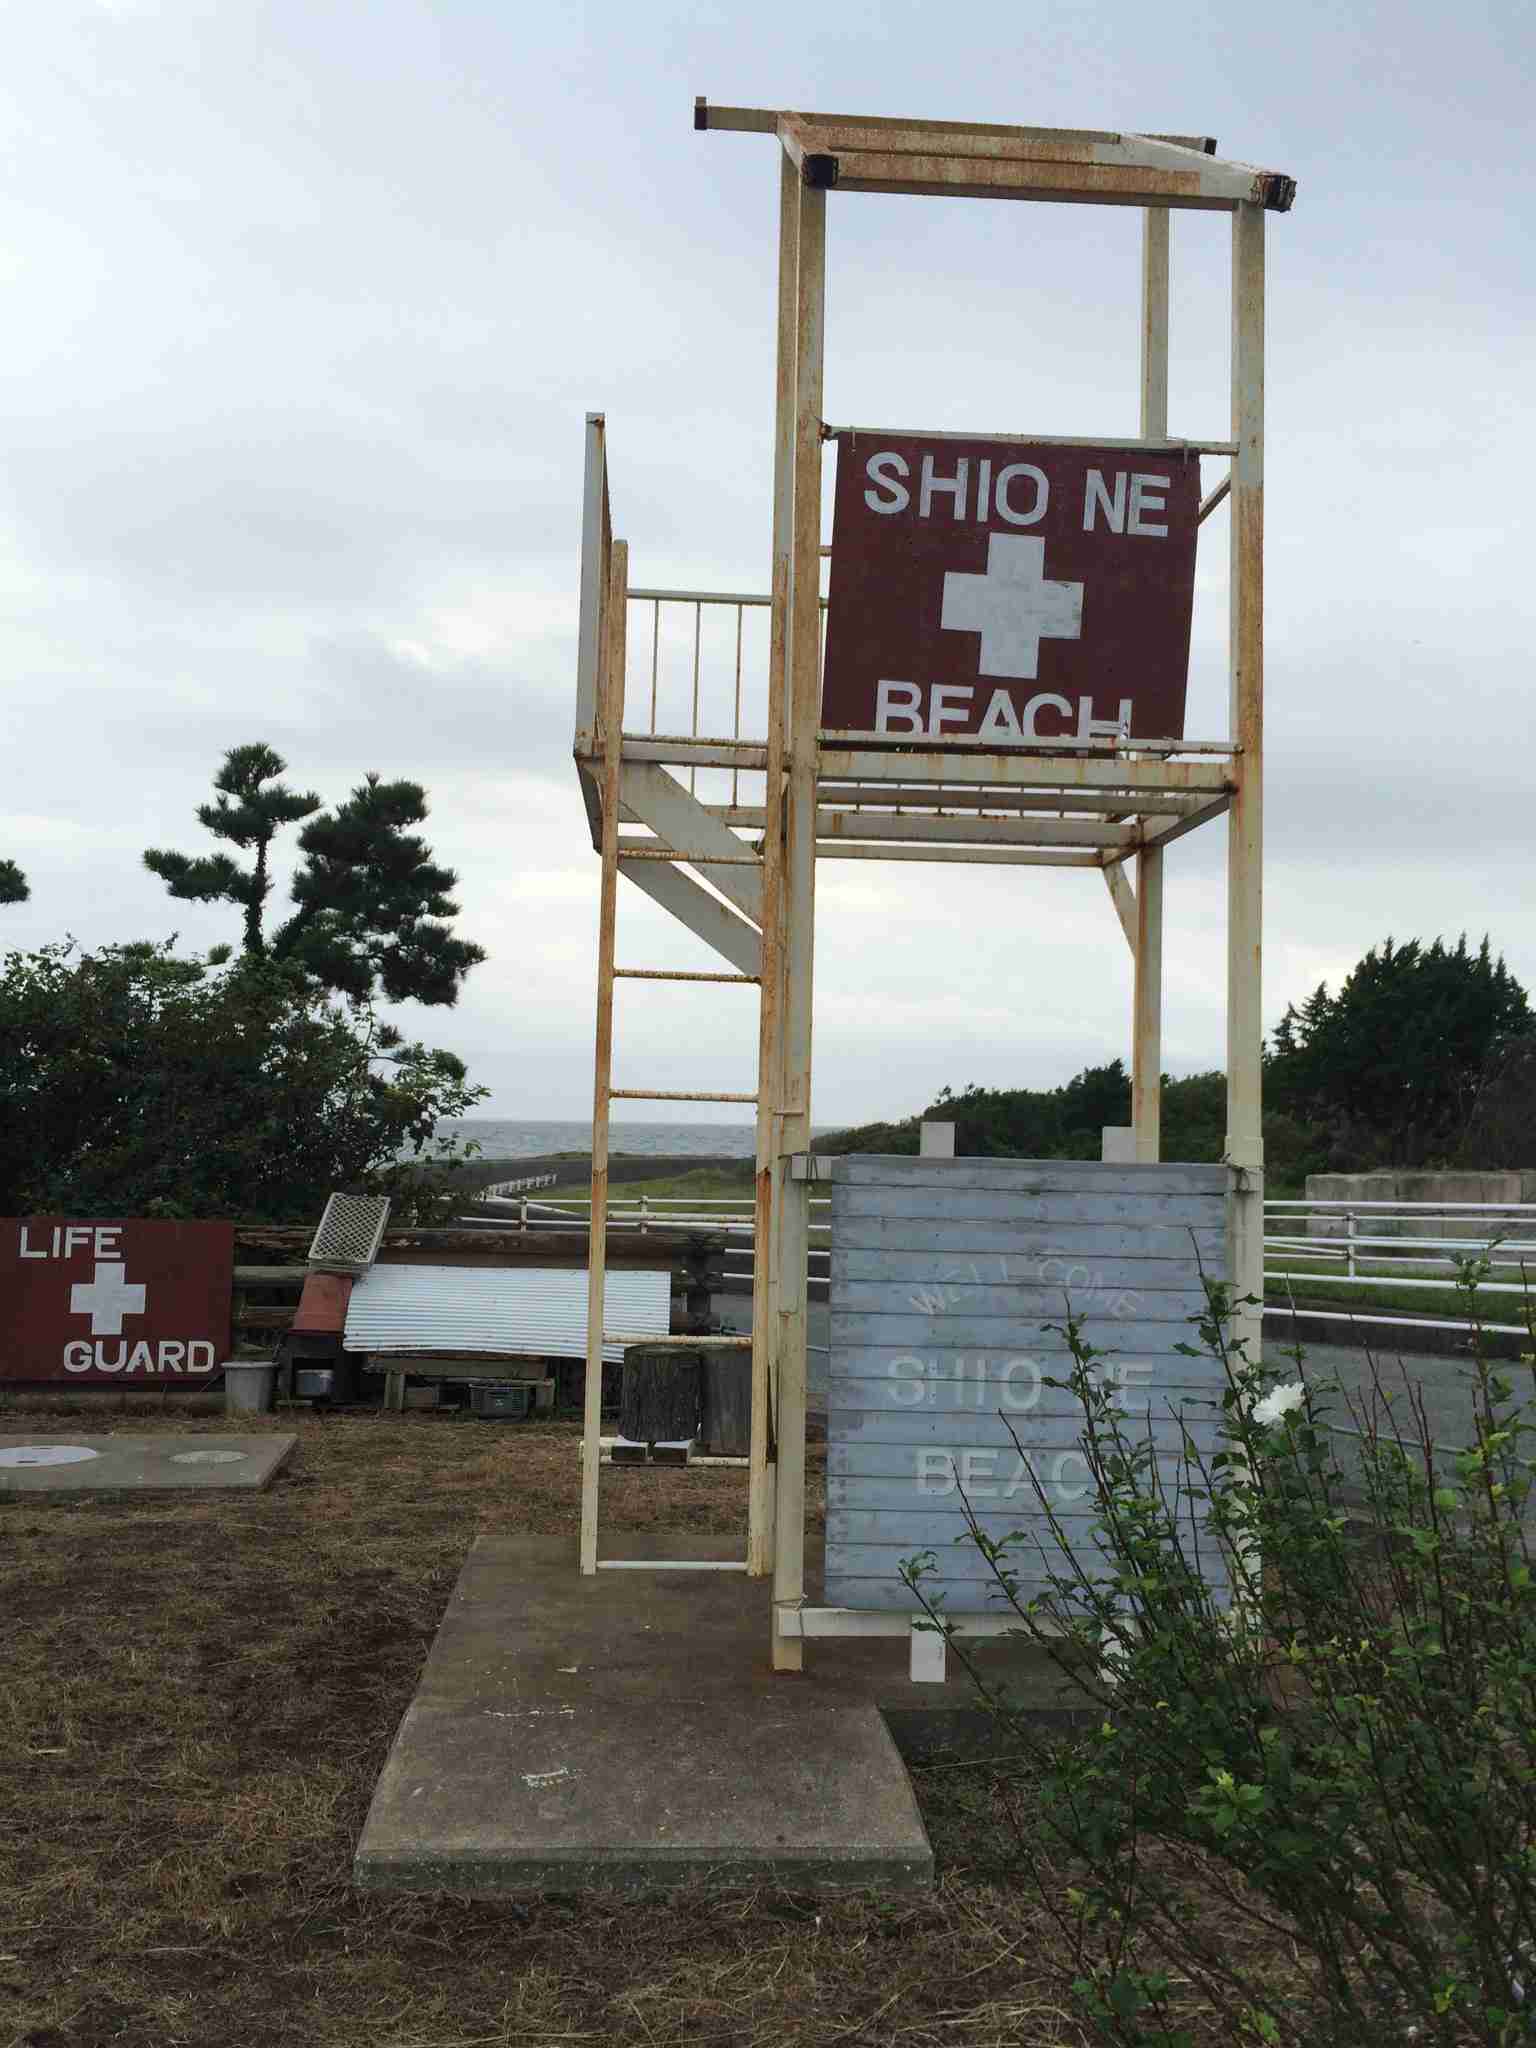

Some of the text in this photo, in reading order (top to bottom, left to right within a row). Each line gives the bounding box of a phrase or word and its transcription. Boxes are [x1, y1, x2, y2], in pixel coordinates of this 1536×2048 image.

[864, 452, 1171, 538] SHIO NE
[874, 679, 1134, 744] BEACH
[19, 1226, 123, 1258] LIFE
[63, 1340, 216, 1373] GUARD
[914, 1447, 1100, 1501] BEAC
